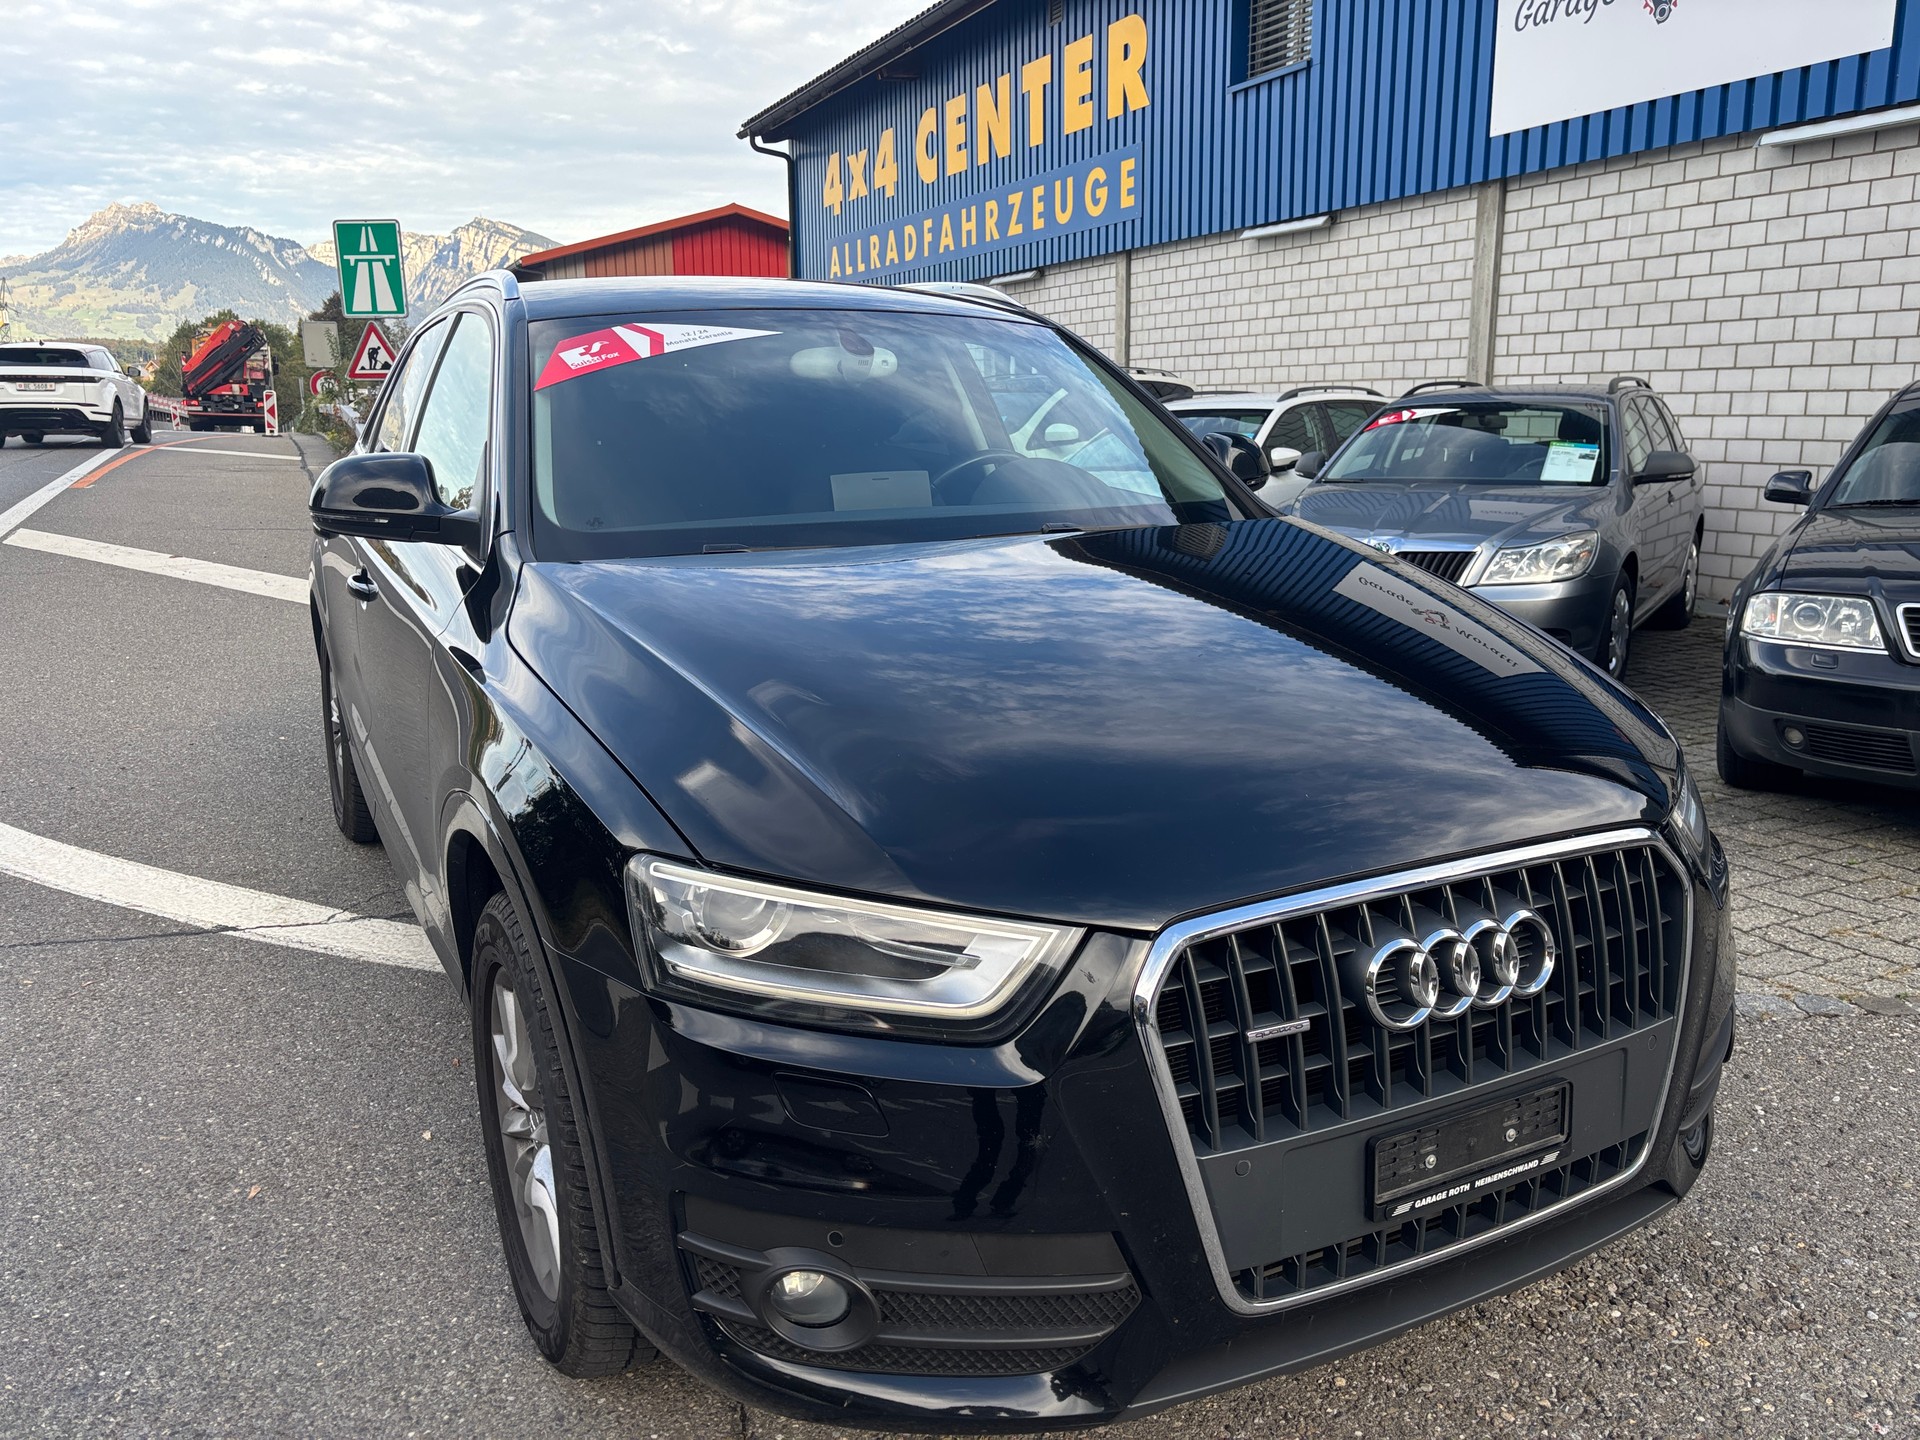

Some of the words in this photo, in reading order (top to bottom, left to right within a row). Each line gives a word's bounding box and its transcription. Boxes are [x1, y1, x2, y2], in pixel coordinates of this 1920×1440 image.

[1515, 0, 1614, 31] Garag
[823, 127, 898, 217] 4x4
[915, 13, 1151, 185] CENTER
[829, 157, 1136, 280] ALLRADFAHRZEUGE
[665, 337, 697, 346] Monate
[698, 331, 734, 340] Garantie
[1255, 1024, 1304, 1038] quattro
[1414, 1190, 1448, 1208] GARAGE
[1448, 1182, 1471, 1197] ROTH
